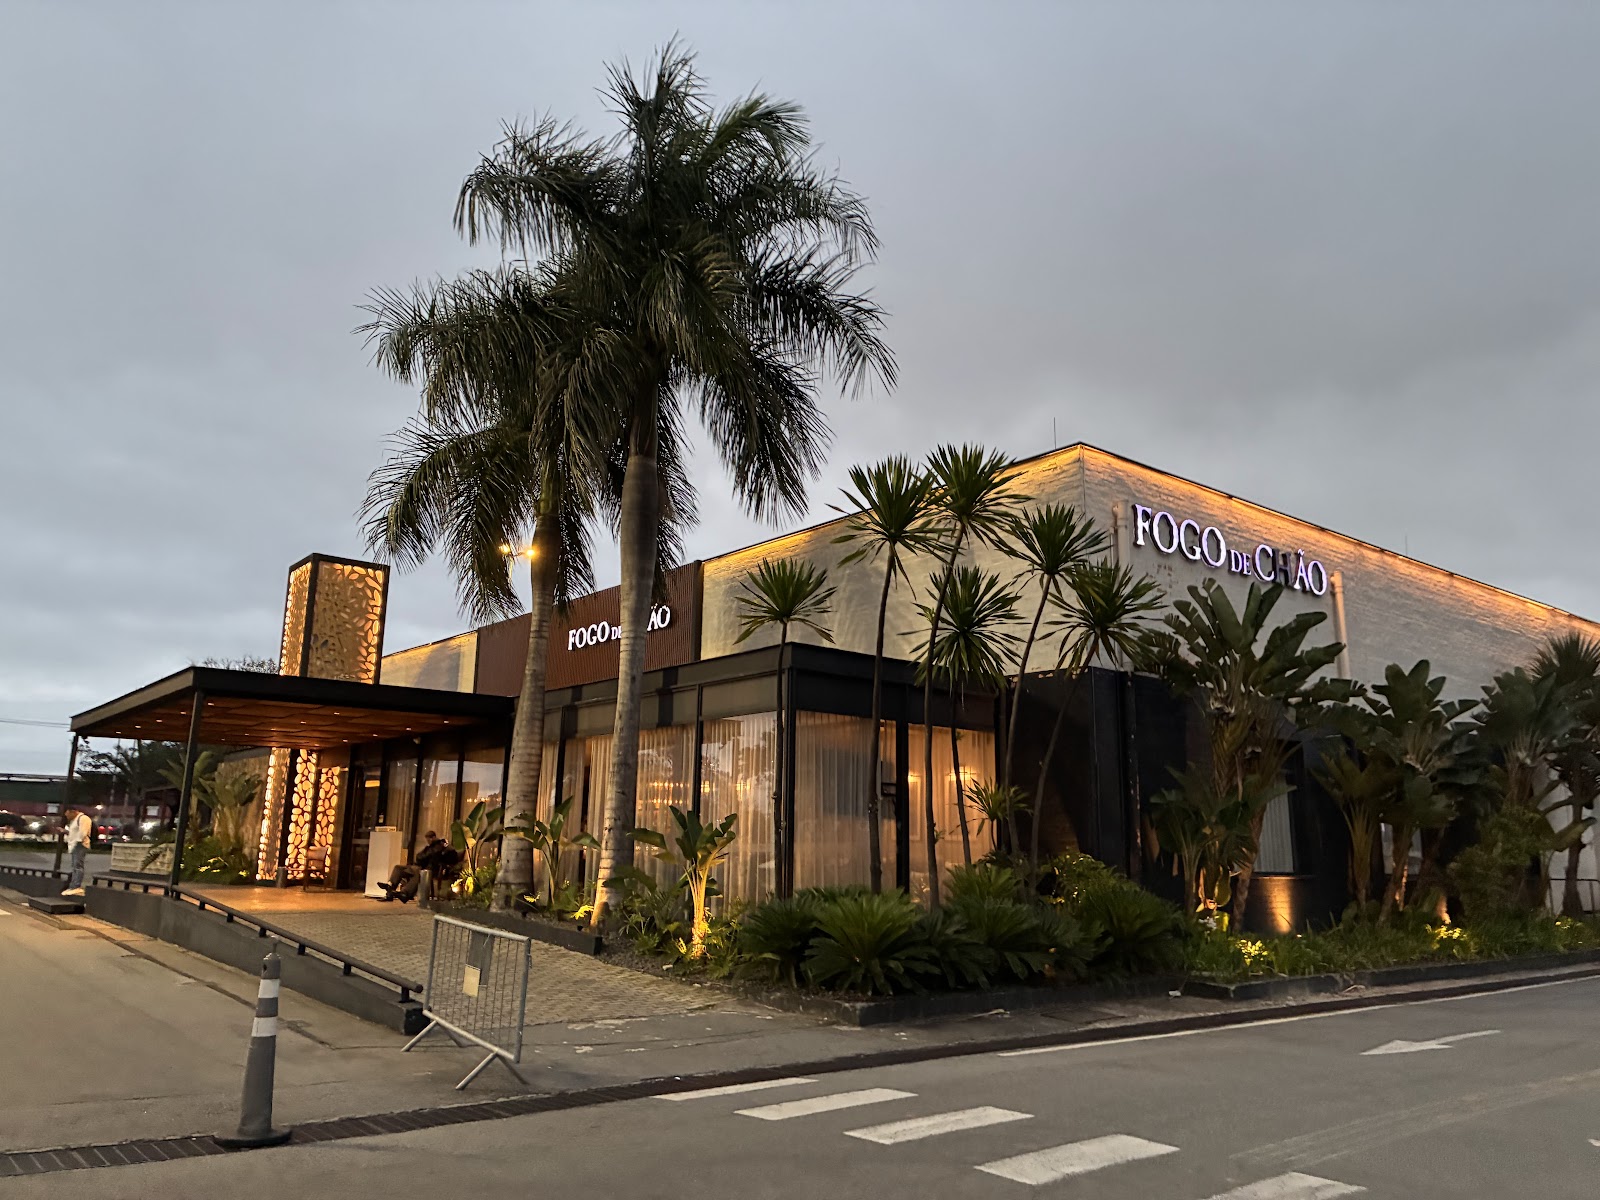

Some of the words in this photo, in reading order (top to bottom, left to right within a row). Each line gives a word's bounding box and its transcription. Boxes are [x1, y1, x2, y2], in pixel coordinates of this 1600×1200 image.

[1133, 504, 1226, 567] FOGO
[1229, 549, 1251, 575] DE
[1252, 544, 1327, 596] CHÃO
[567, 621, 610, 651] FOGO
[647, 603, 671, 632] ÃO
